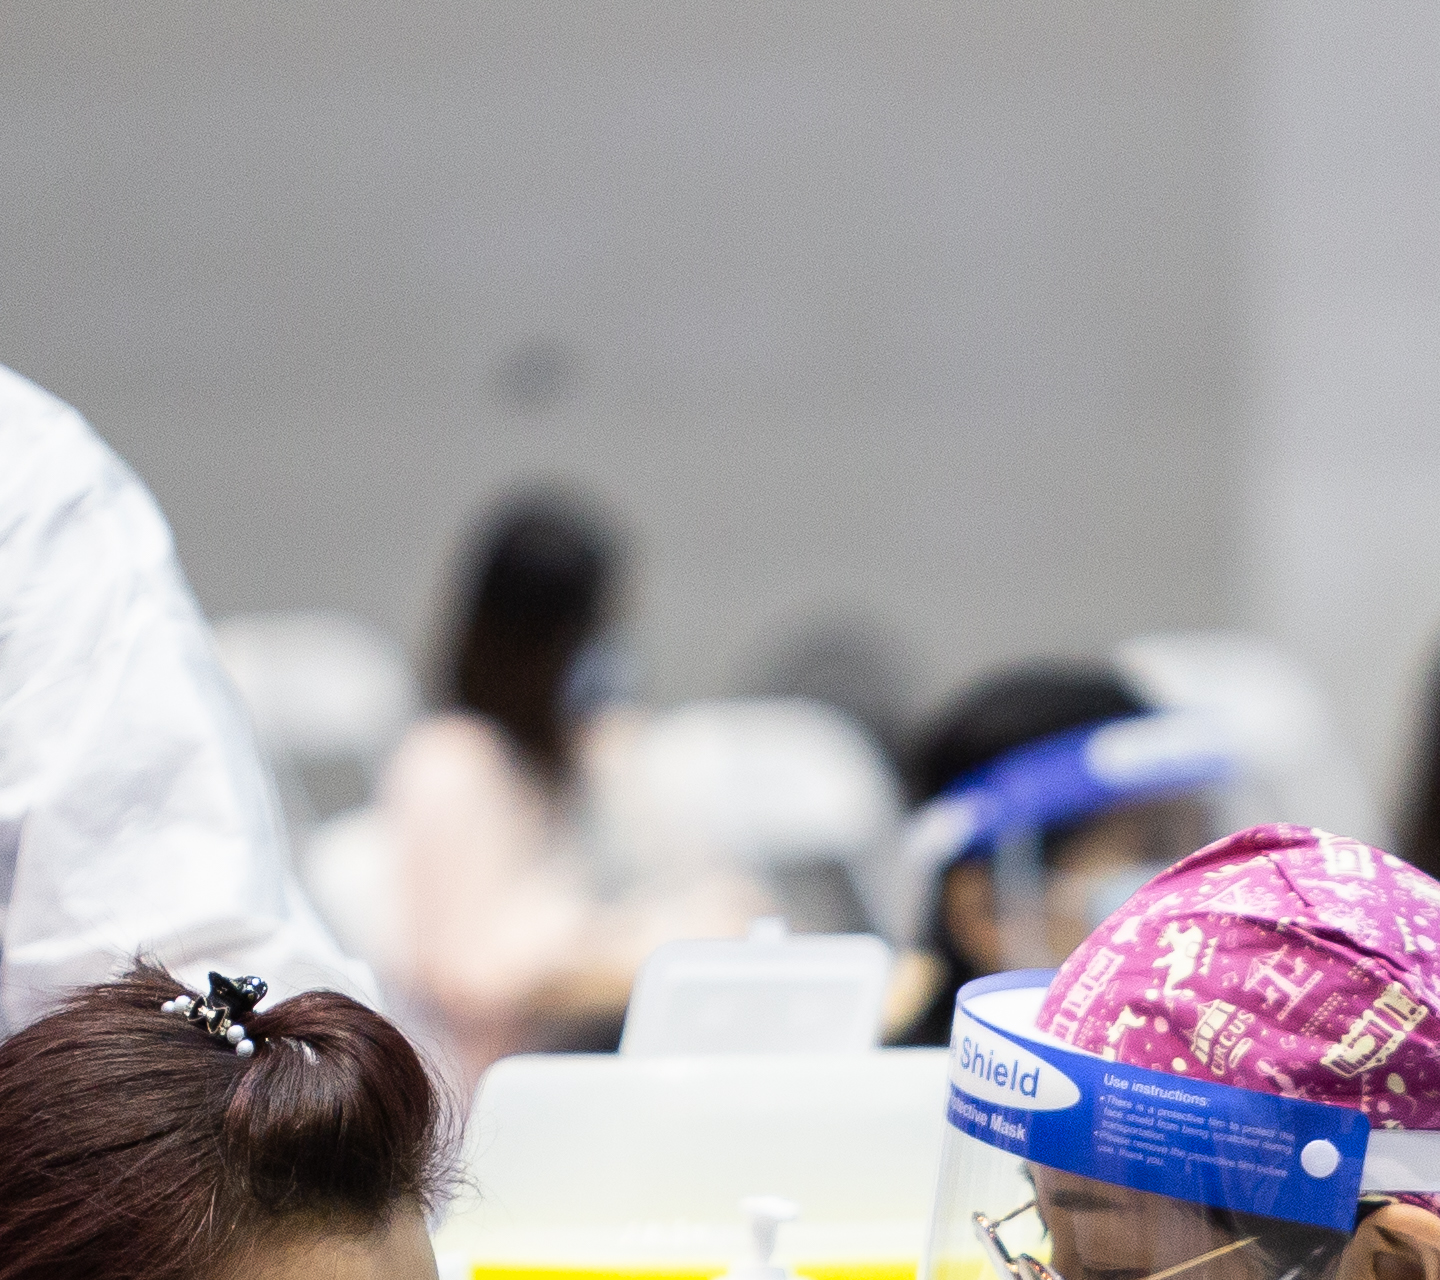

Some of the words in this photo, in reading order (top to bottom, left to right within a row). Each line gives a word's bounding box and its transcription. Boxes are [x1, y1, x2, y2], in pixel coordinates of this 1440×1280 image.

[1211, 1008, 1255, 1076] CIRCUS
[961, 1036, 1040, 1098] Shield
[1103, 1073, 1129, 1090] Use
[989, 1112, 1027, 1141] Mask
